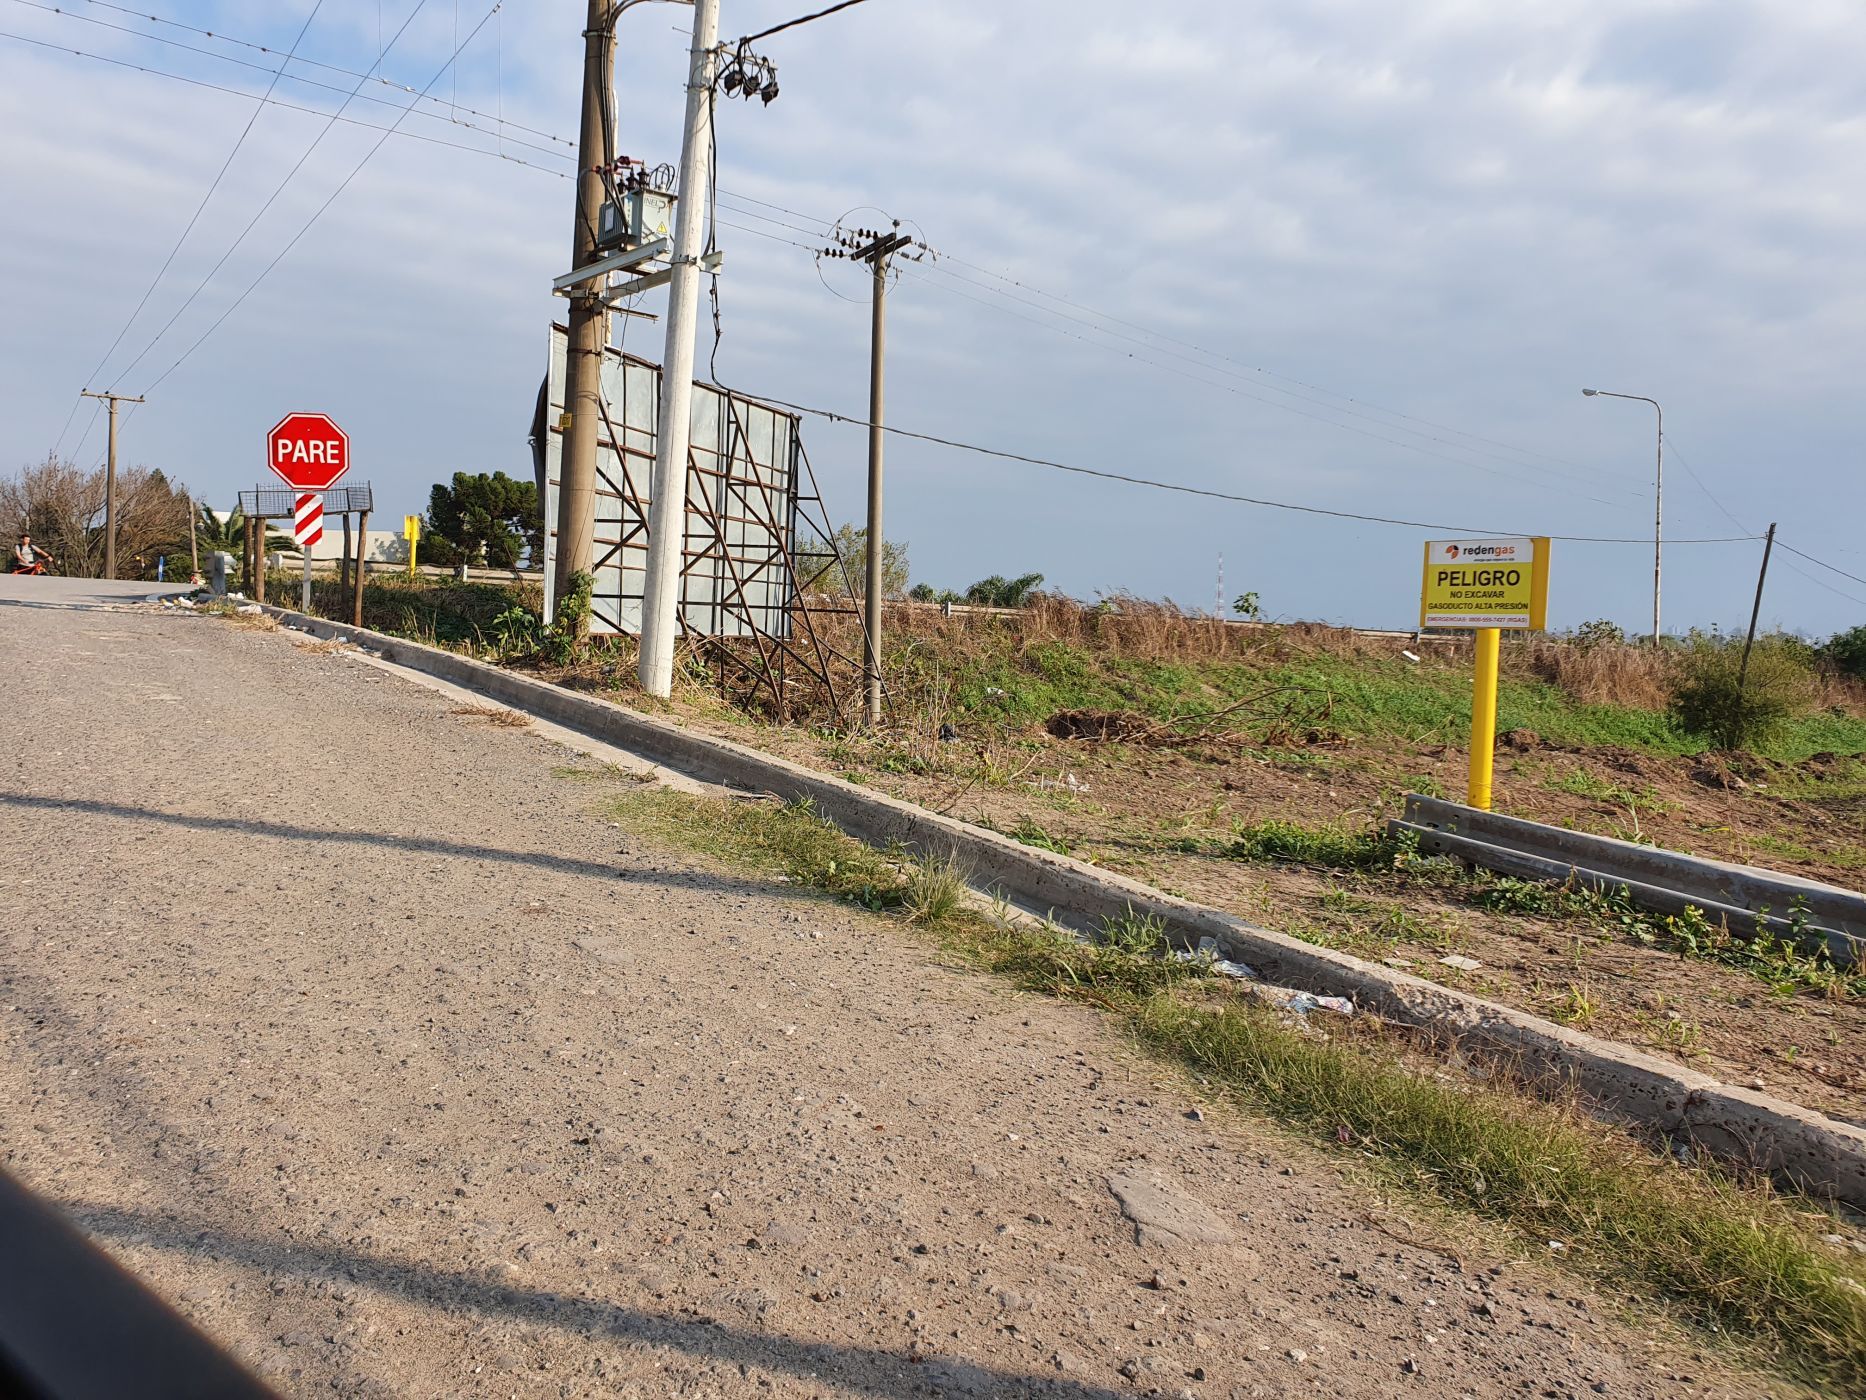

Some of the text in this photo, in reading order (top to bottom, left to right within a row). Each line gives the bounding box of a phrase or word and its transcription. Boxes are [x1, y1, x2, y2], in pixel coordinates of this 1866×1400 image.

[277, 439, 340, 464] PARE
[1463, 545, 1515, 557] redengas
[1437, 570, 1520, 586] PELIGRO
[1450, 590, 1505, 599] NO EXCAVAR
[1475, 602, 1493, 610] ALTA
